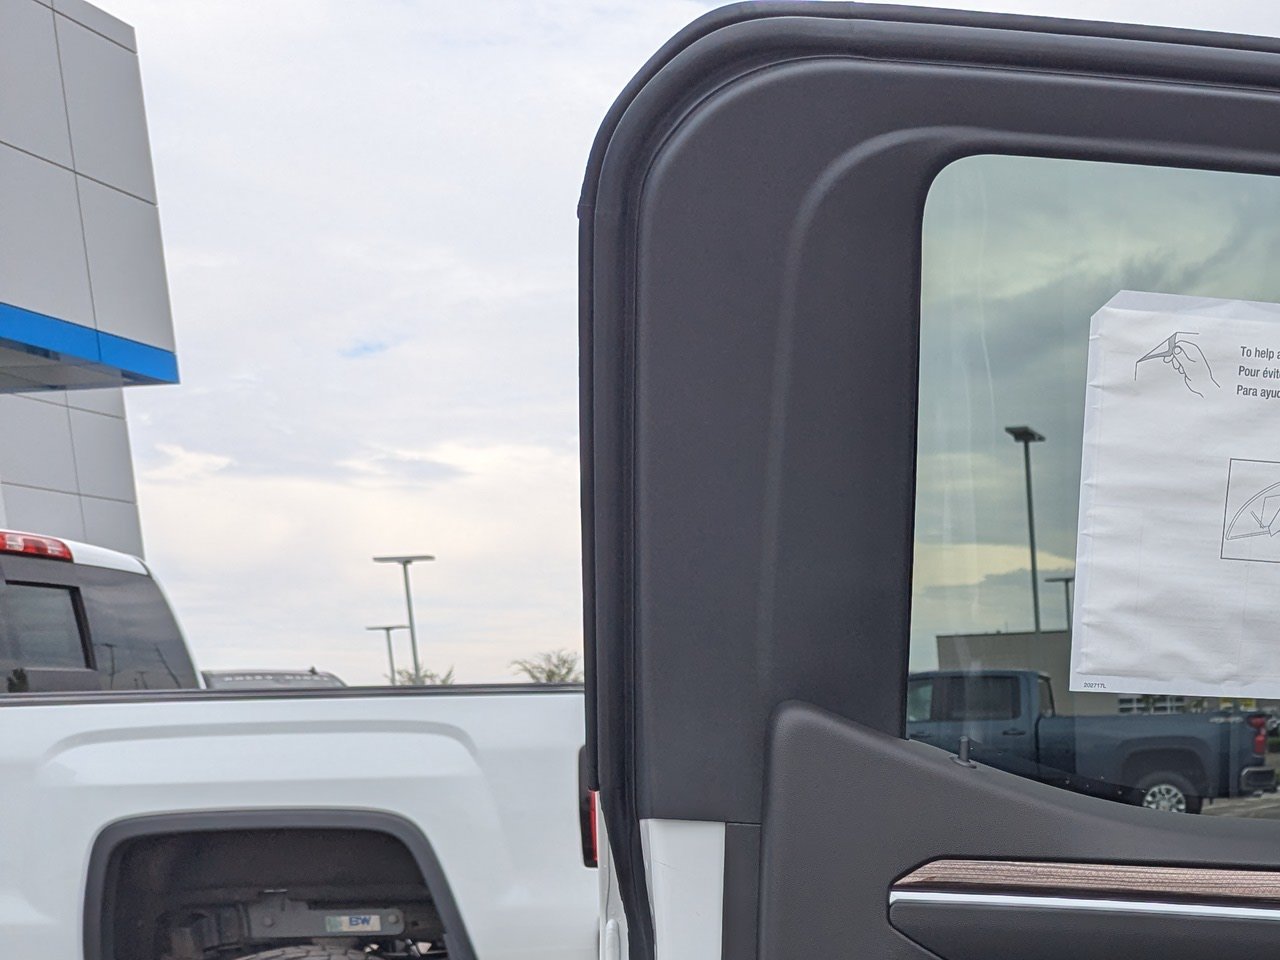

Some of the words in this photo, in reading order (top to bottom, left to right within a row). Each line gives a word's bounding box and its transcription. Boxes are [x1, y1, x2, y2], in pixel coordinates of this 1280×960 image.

[1240, 346, 1252, 358] To
[1254, 346, 1275, 361] help
[1238, 365, 1260, 378] Pour
[1236, 384, 1258, 397] Para
